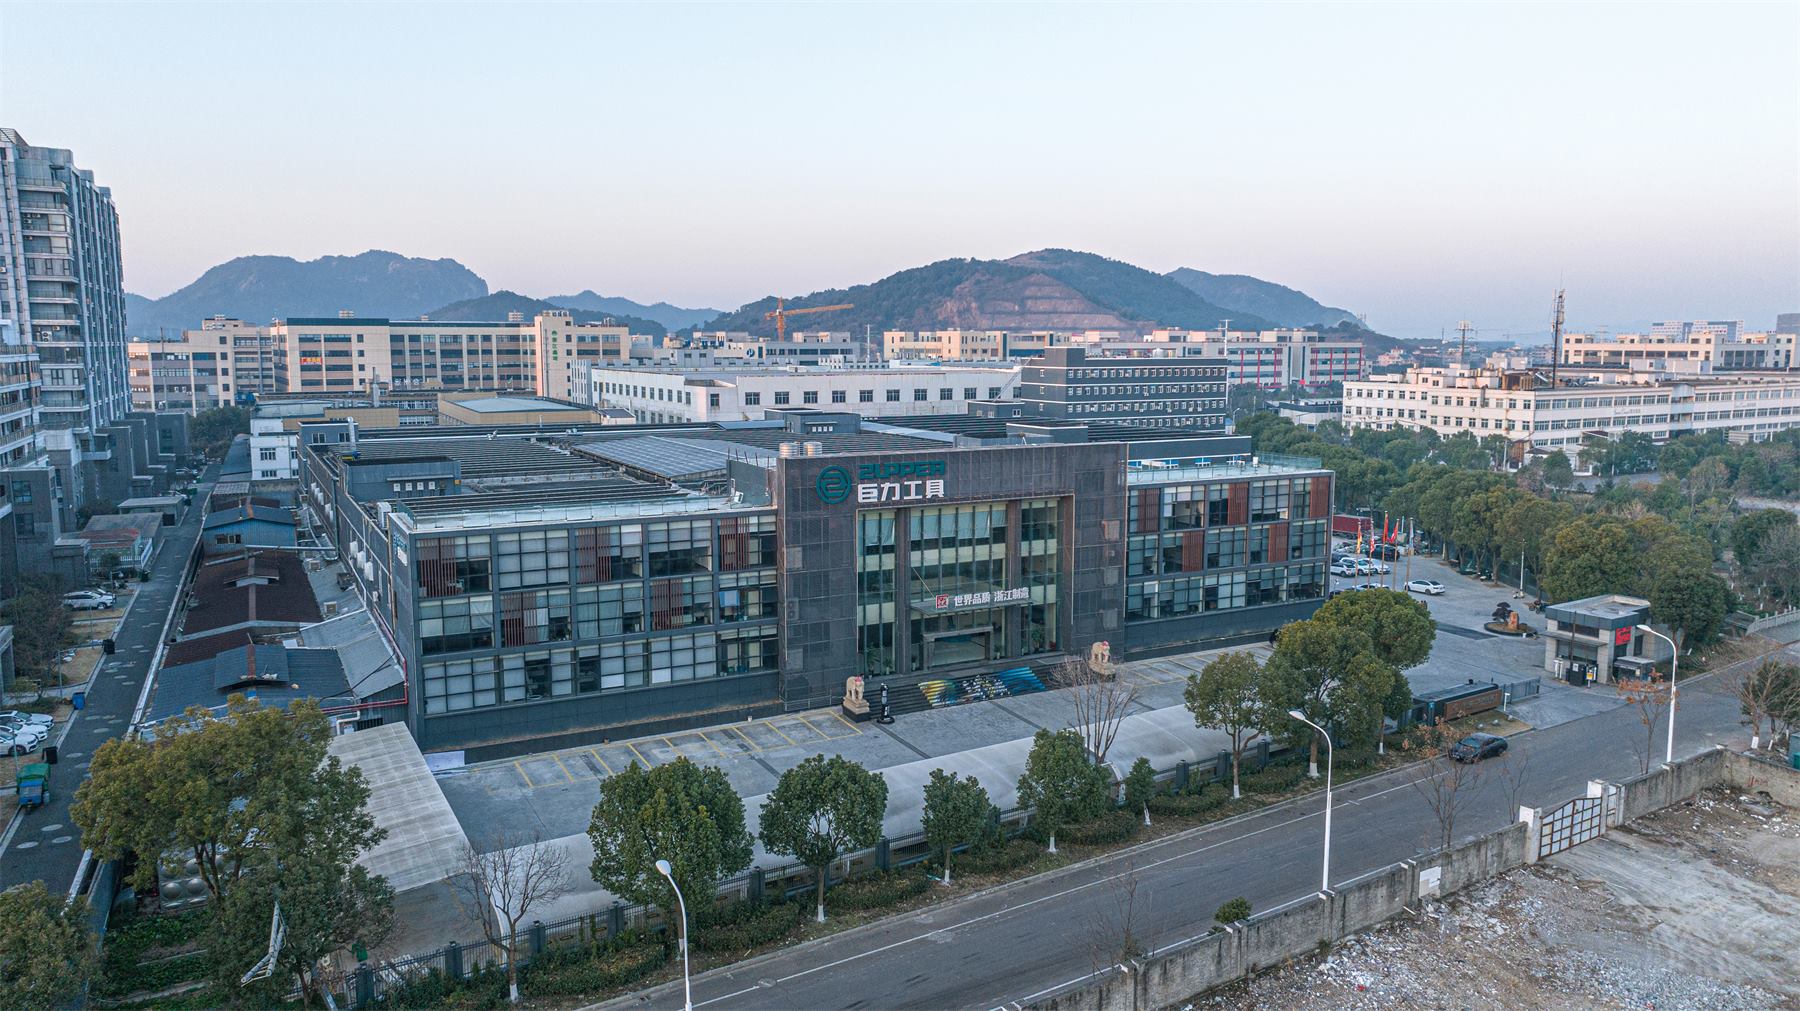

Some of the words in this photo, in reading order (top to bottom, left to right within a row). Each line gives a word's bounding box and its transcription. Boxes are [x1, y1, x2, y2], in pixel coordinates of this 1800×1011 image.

[858, 479, 945, 503] 巨力工具
[953, 591, 991, 607] 世界品质
[994, 587, 1030, 602] 浙江制造
